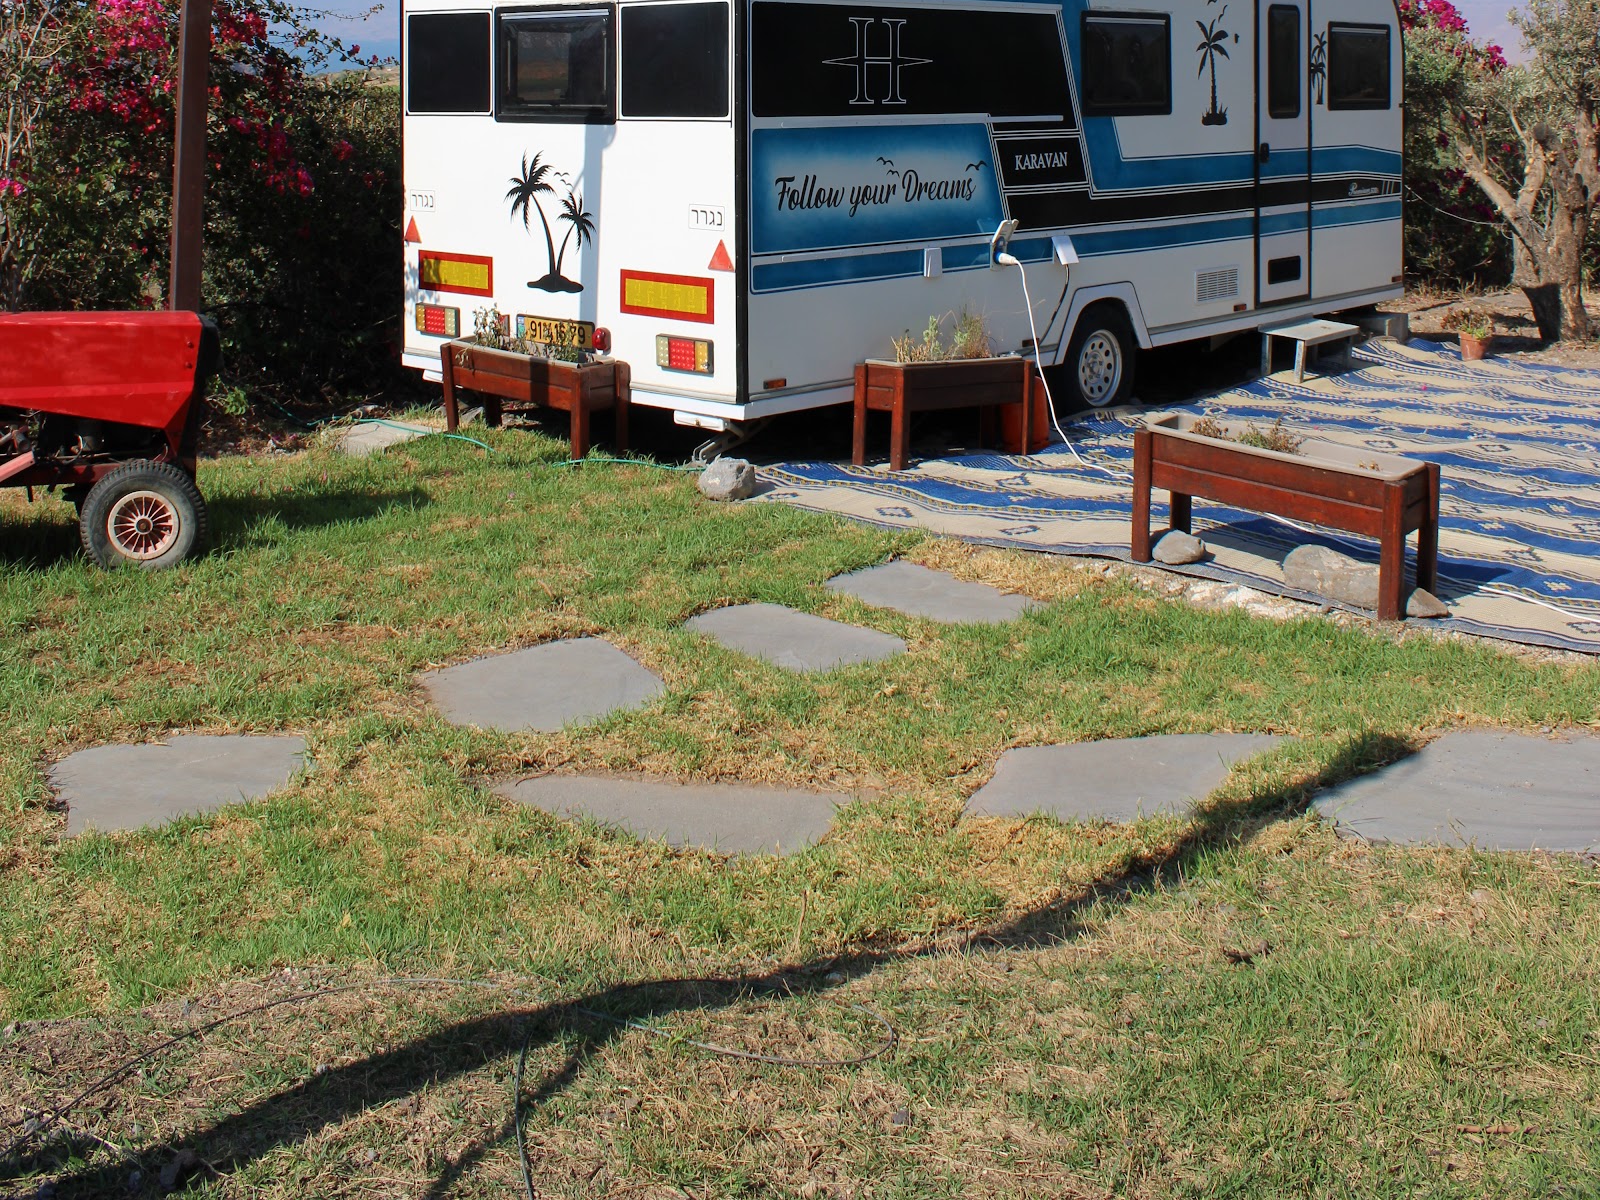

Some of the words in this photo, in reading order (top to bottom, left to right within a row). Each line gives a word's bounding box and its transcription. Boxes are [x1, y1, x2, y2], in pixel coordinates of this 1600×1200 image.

[1015, 151, 1068, 171] KARAVAN
[411, 194, 434, 208] נגרר
[774, 174, 845, 212] Follow
[849, 182, 897, 218] your
[901, 169, 977, 203] Dreams
[691, 209, 723, 227] נגרר
